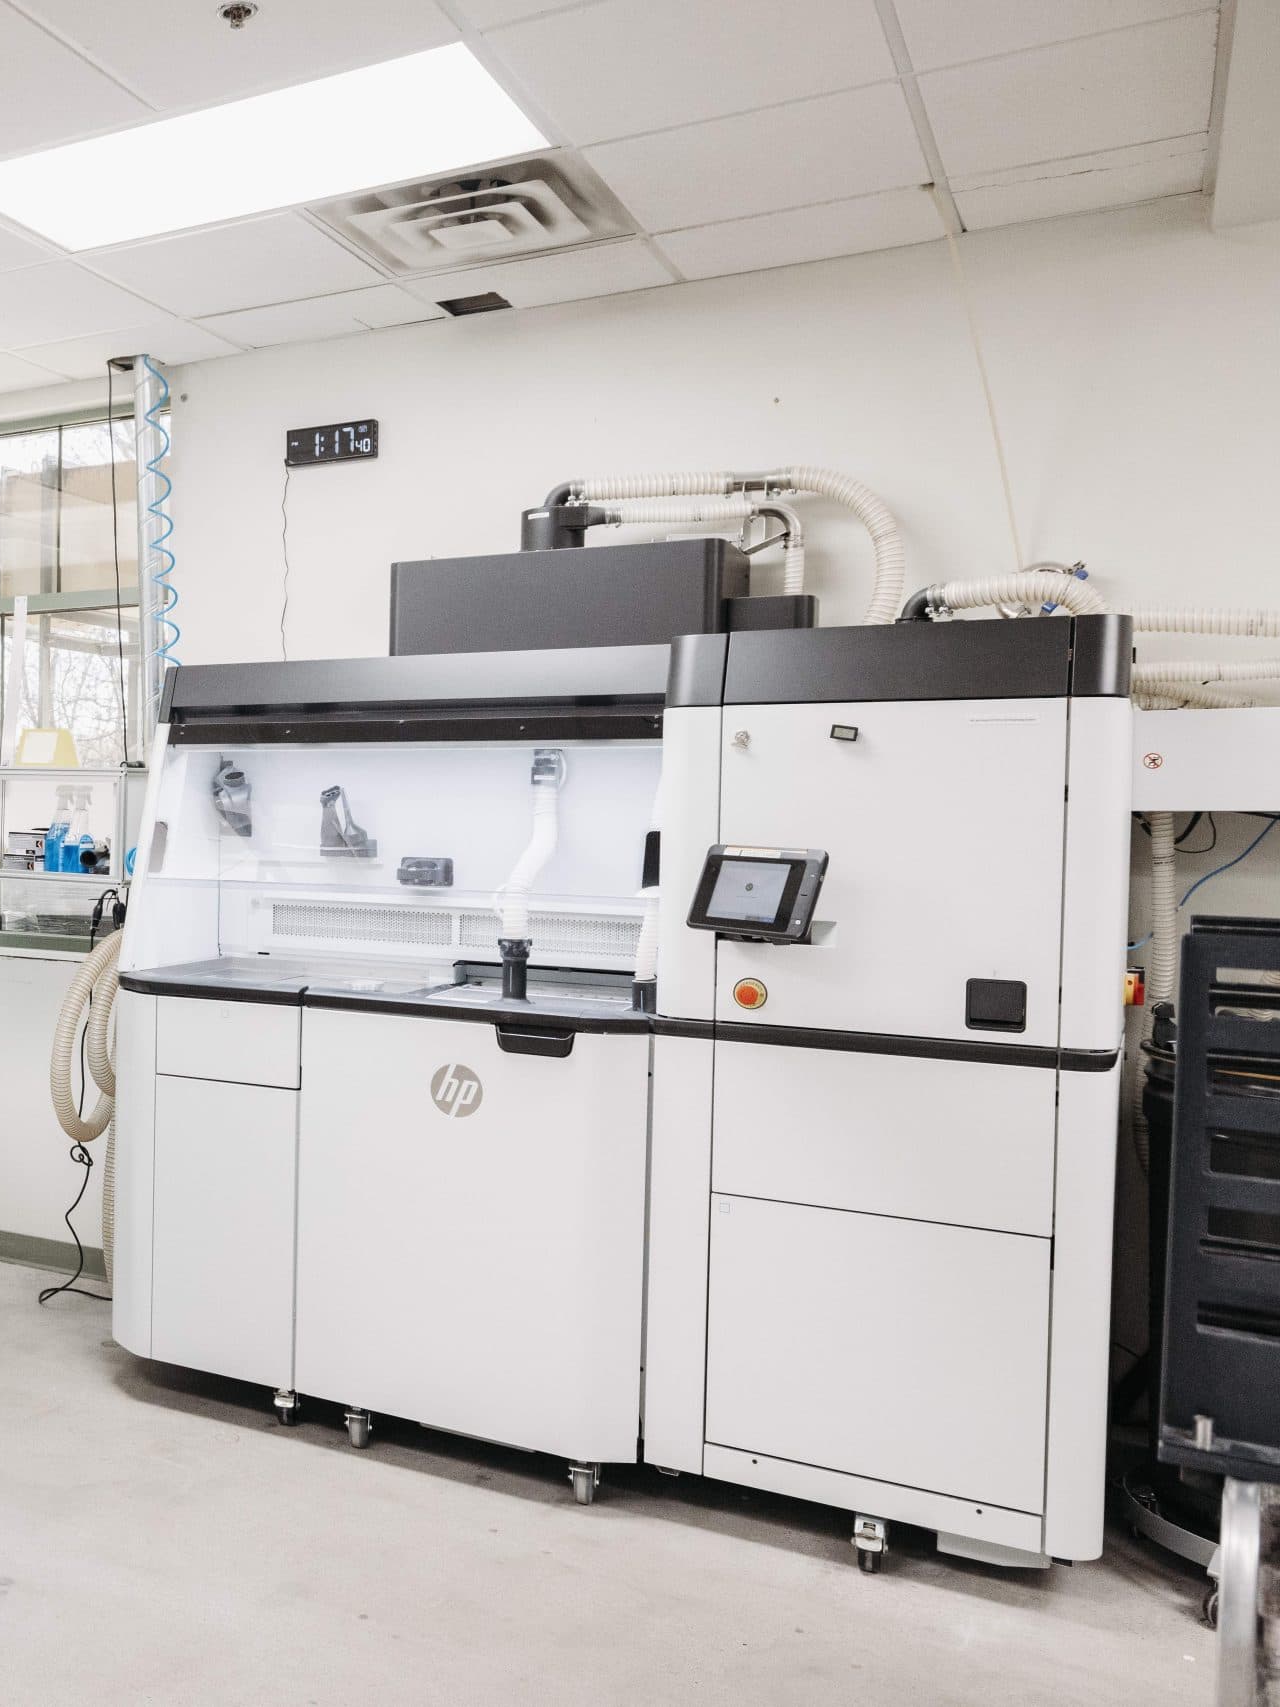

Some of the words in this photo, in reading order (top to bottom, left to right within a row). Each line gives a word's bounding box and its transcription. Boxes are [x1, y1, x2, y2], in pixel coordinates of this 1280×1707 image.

[314, 426, 355, 457] 1:17
[355, 438, 371, 453] 40
[435, 1063, 480, 1119] hp
